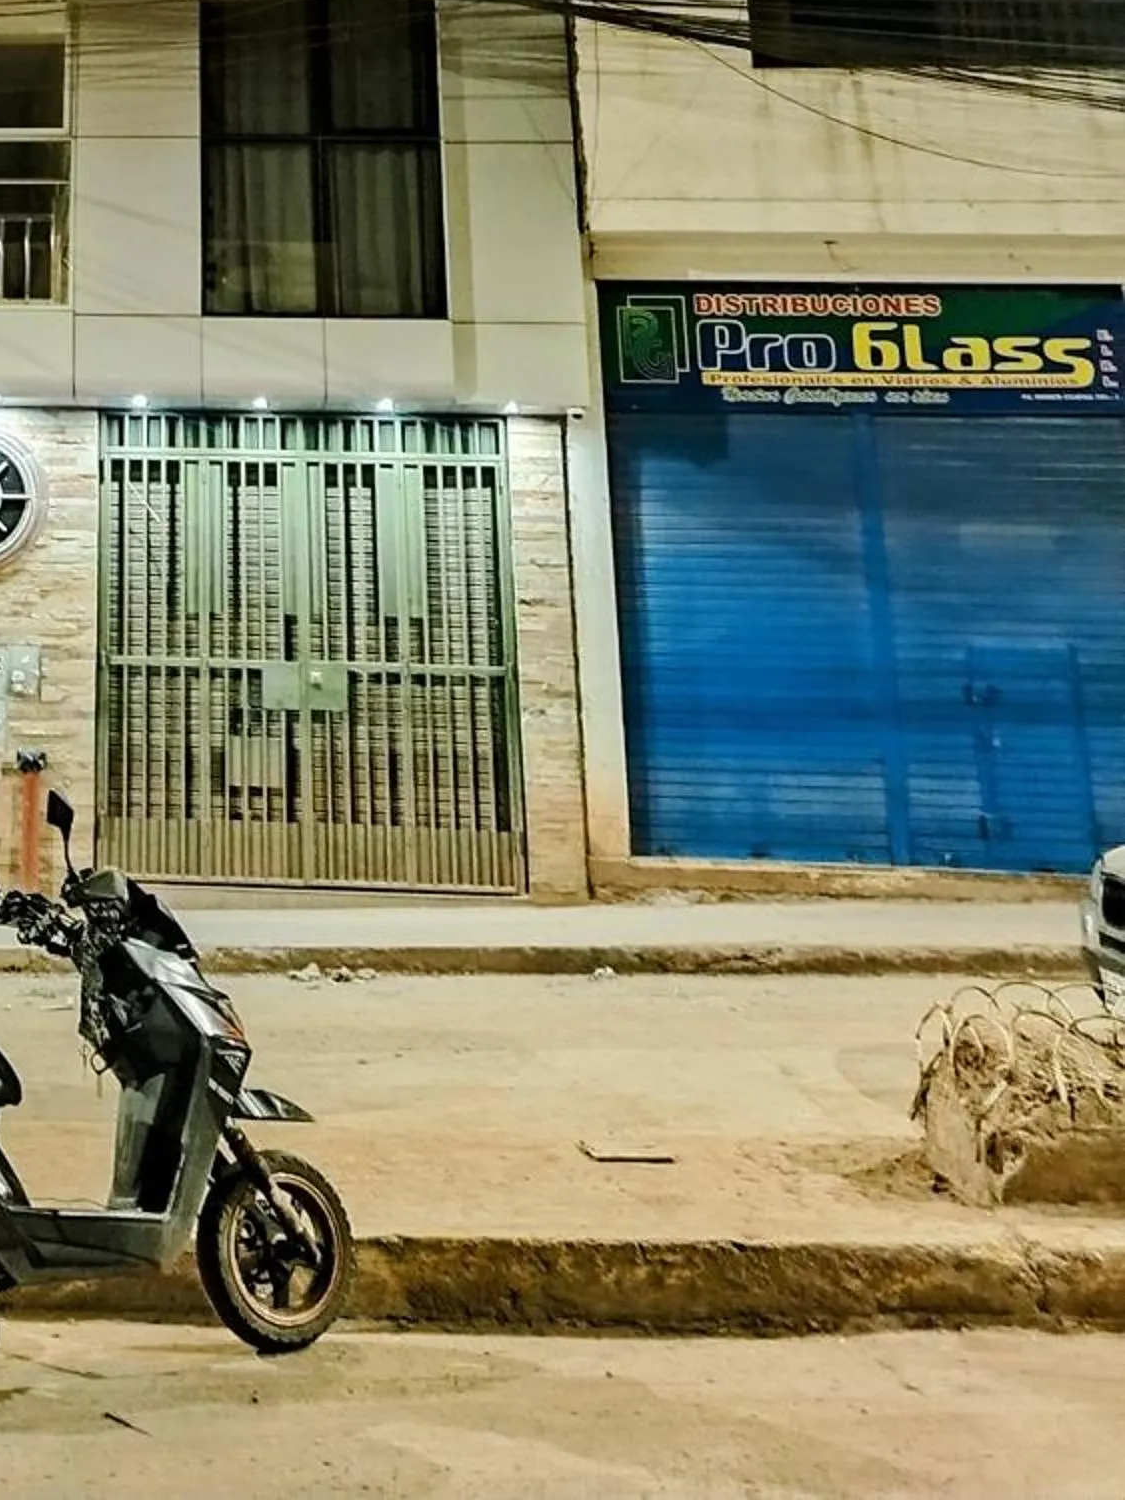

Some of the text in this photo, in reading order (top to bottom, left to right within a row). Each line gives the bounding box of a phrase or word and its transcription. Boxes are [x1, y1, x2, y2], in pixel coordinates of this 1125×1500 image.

[694, 293, 942, 317] DISTRIBUCIONES
[696, 319, 837, 372] Pro
[709, 373, 841, 385] Profesionales
[851, 375, 875, 385] en
[882, 373, 954, 386] Vidrios
